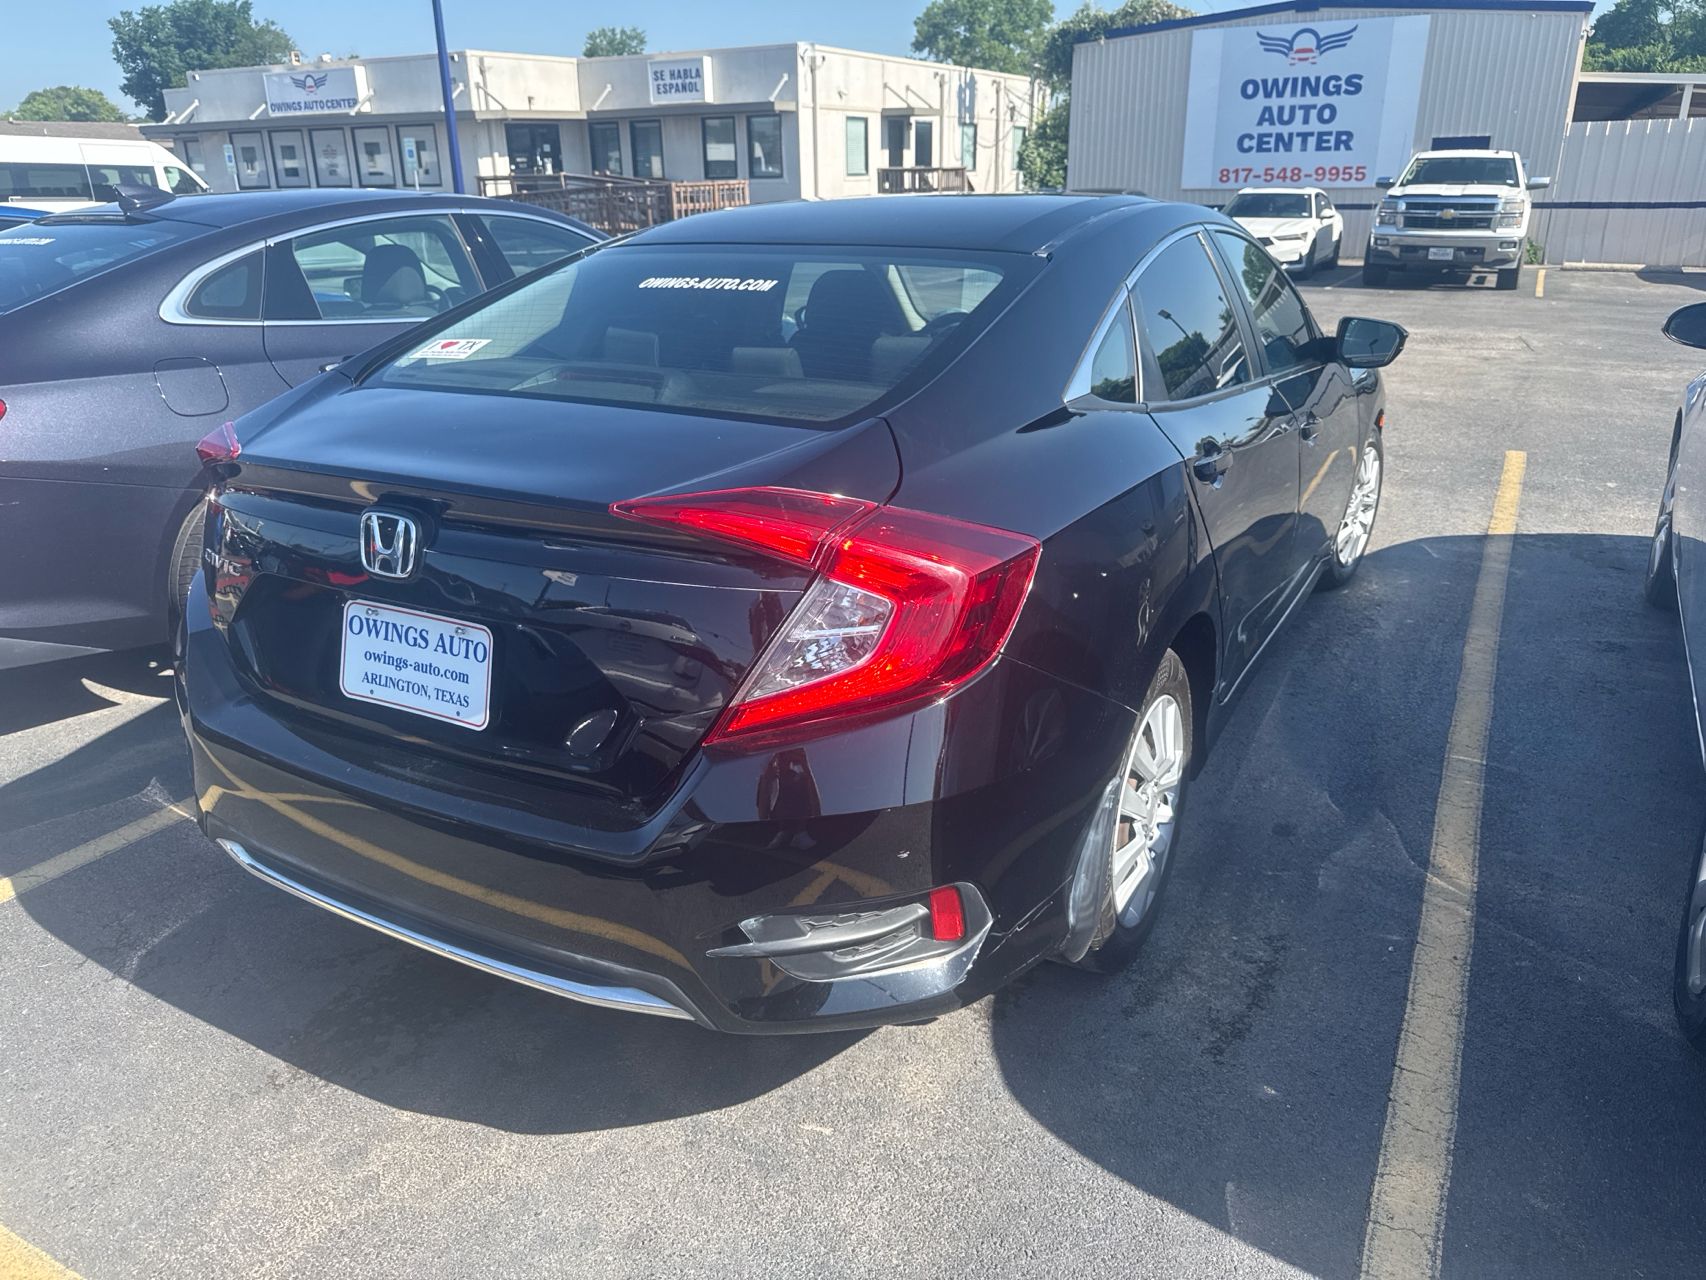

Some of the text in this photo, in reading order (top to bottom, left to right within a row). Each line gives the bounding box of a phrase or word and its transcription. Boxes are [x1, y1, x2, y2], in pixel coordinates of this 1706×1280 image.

[653, 67, 701, 82] SE HABLA
[1240, 74, 1364, 100] OWINGS
[270, 101, 303, 112] OWINGS
[304, 100, 325, 111] AUTO
[1256, 103, 1338, 126] AUTO
[1236, 130, 1354, 153] CENTER
[1218, 166, 1367, 183] 817-548-9955
[205, 547, 242, 576] CIVIC
[349, 615, 488, 663] OWINGS AUTO
[364, 650, 469, 684] owings-auto.com
[362, 671, 470, 708] ARLINGTON, TEXAS
